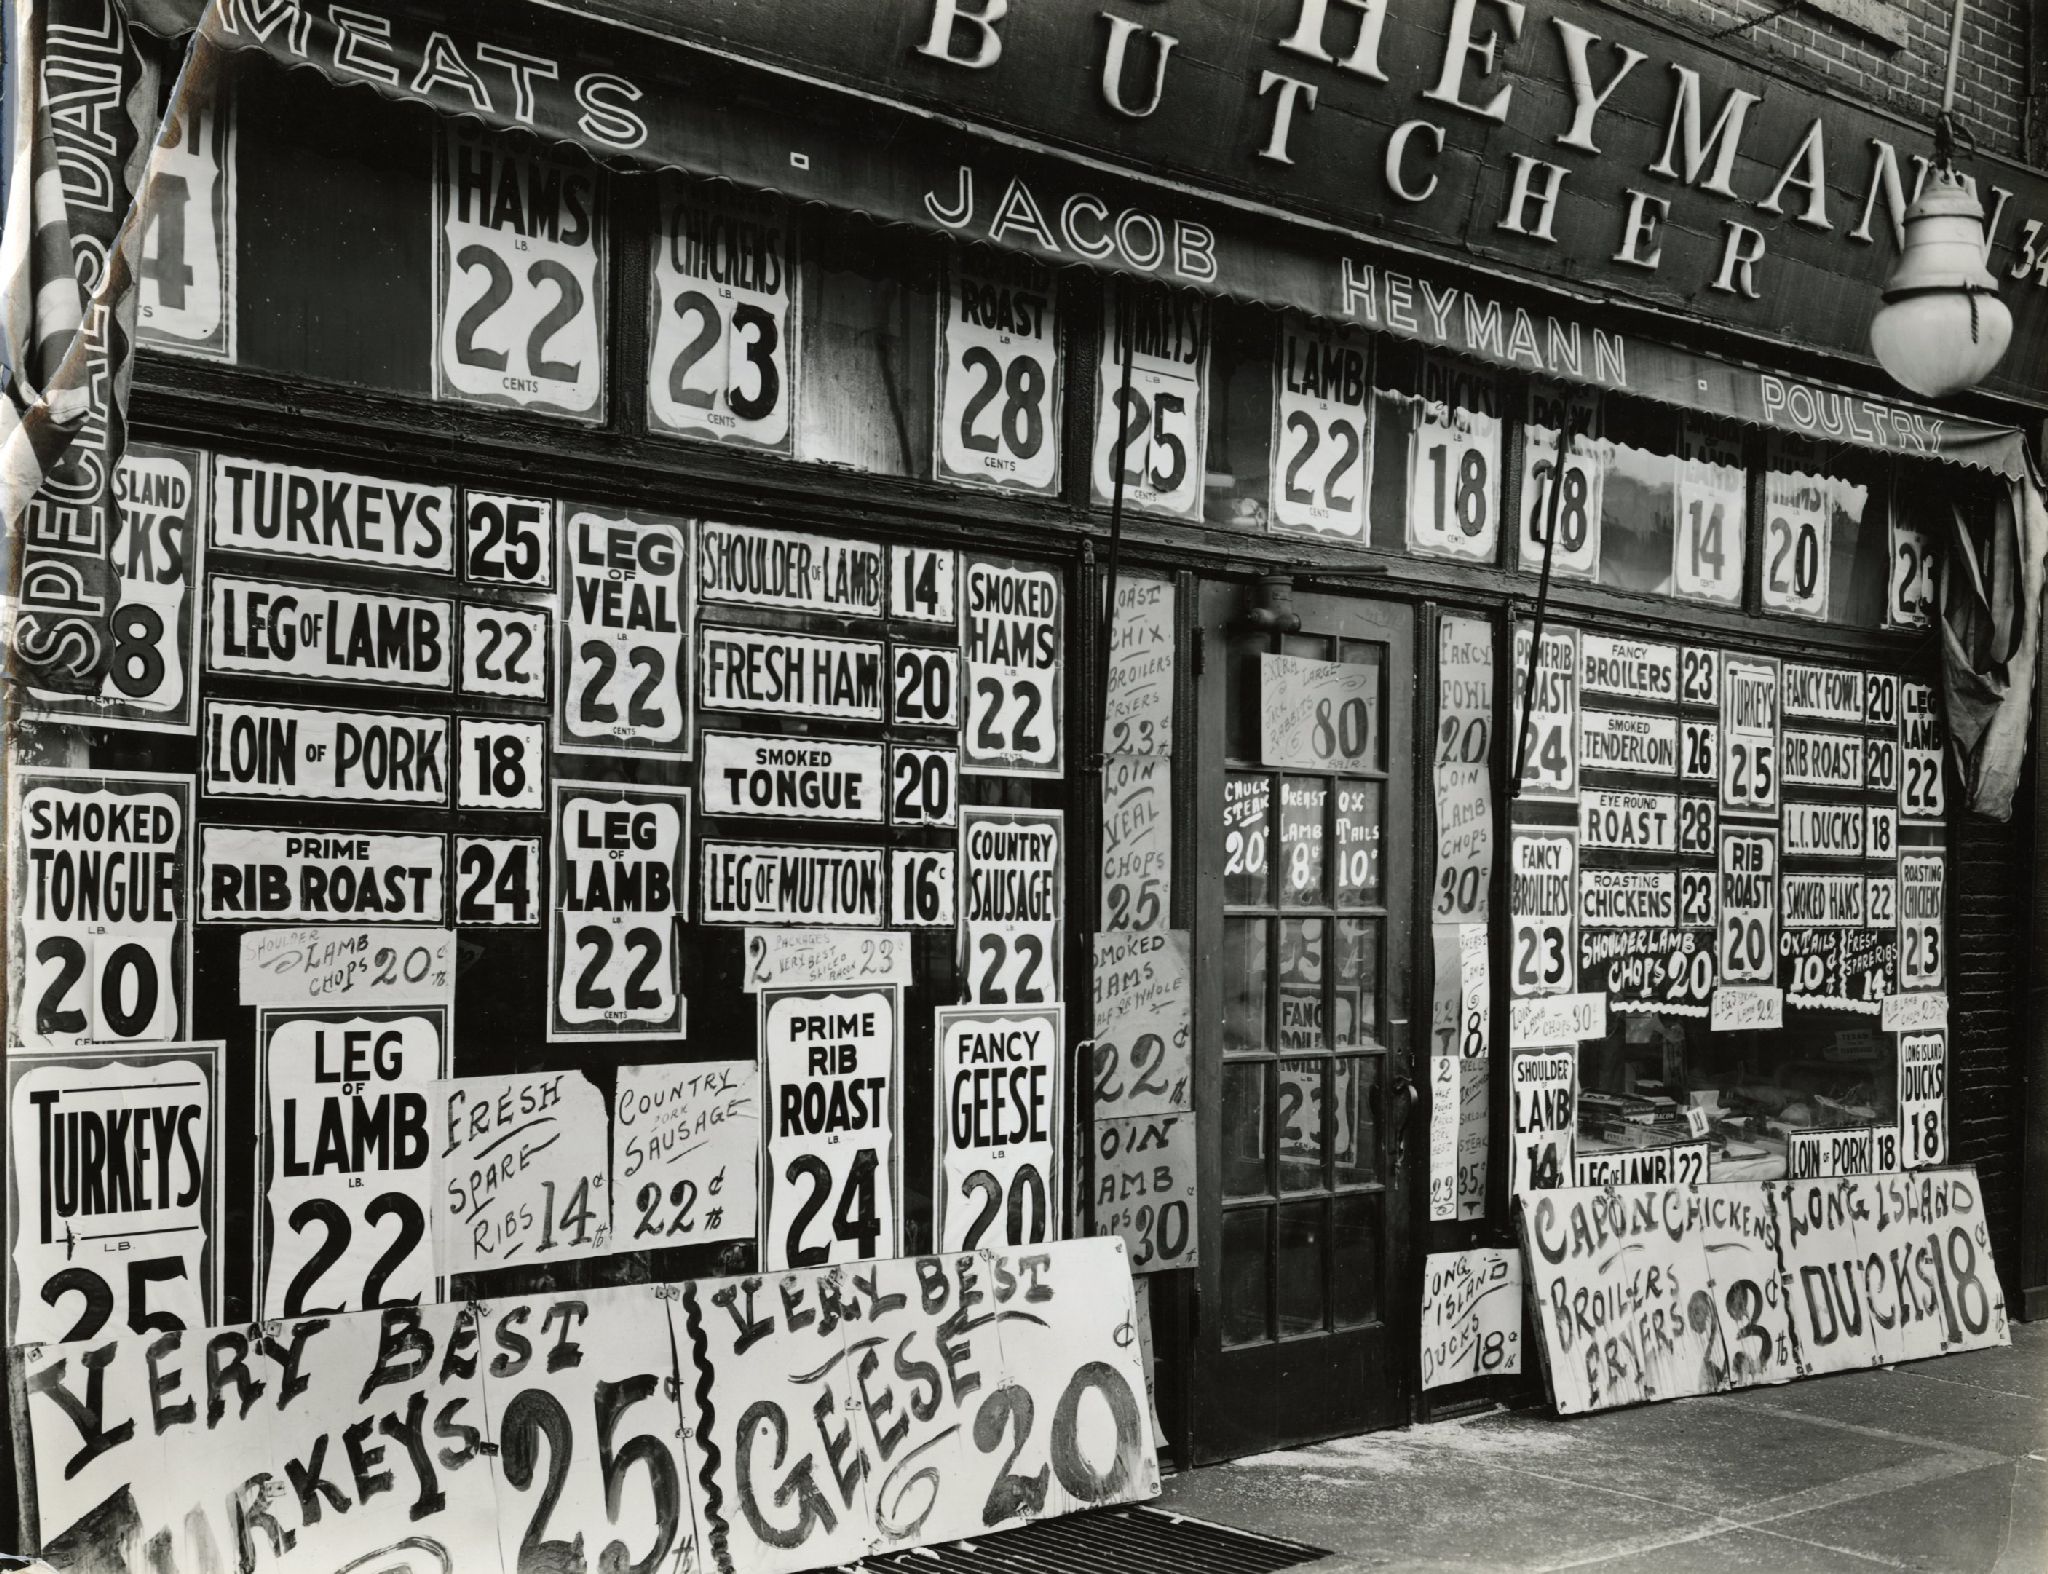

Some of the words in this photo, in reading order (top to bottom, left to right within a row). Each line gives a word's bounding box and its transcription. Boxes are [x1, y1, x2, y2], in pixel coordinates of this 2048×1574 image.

[212, 0, 648, 149] MEATS
[914, 0, 1765, 299] BUTCHER
[923, 166, 1218, 283] JACOB
[1340, 257, 1627, 388] HEYMANN
[502, 377, 540, 394] CENTS
[706, 413, 736, 428] CENTS
[1761, 374, 1944, 453] POULTRY
[984, 456, 1016, 472] CENTS
[225, 466, 442, 559] TURKEYS
[469, 502, 541, 580] 25
[578, 523, 676, 577] LEG
[1690, 500, 1725, 581] 14
[608, 568, 636, 581] OF
[971, 571, 1054, 619] SMOKED
[576, 575, 677, 633] VEAL
[223, 589, 298, 662] LEG
[301, 613, 324, 649] OF
[327, 600, 442, 673] LAMB
[476, 619, 533, 684] 22
[971, 616, 1055, 670] HAMS
[1611, 644, 1648, 660] FANCY
[580, 639, 666, 729] 22
[709, 639, 804, 704] FRESH
[812, 647, 878, 708] HAM
[896, 652, 951, 720] 20
[1108, 655, 1171, 693] BROILERS
[1441, 680, 1491, 710] FOWL
[1586, 655, 1672, 693] BROILERS
[1785, 668, 1823, 709] FANCY
[1824, 673, 1861, 712] FOWL
[977, 677, 1041, 753] 22
[1868, 676, 1894, 721] 20
[612, 726, 636, 736] CENTS
[1112, 720, 1155, 755] 23
[1312, 697, 1369, 760] 80
[1440, 715, 1487, 764] 20
[1584, 730, 1673, 767] TENDERLOIN
[1608, 718, 1651, 735] SMOKED
[212, 713, 297, 786] LOIN
[305, 744, 327, 763] OF
[335, 722, 444, 793] PORK
[474, 735, 526, 798] 18
[755, 748, 832, 767] SMOKED
[1785, 737, 1808, 777] RIB
[1812, 740, 1860, 780] ROAST
[1868, 741, 1894, 787] 20
[724, 768, 863, 810] TONGUE
[895, 752, 949, 820] 20
[1103, 757, 1155, 804] LOIN
[1224, 778, 1270, 801] CHUCK
[1600, 795, 1621, 808] EYE
[1623, 796, 1657, 810] ROUND
[30, 800, 174, 844] SMOKED
[577, 809, 657, 851] LEG
[1223, 795, 1269, 826] STEAK
[1281, 813, 1323, 843] LAMB
[1336, 818, 1379, 844] TAILS
[1439, 798, 1486, 837] LAMB
[1587, 808, 1668, 845] ROAST
[1812, 811, 1860, 850] DUCKS
[286, 838, 371, 861] PRIME
[608, 850, 625, 860] OF
[971, 829, 1053, 862] COUNTRY
[1224, 831, 1265, 876] 20
[1440, 827, 1488, 860] CHOPS
[1871, 815, 1890, 852] 18
[1104, 852, 1165, 880] CHOPS
[1291, 842, 1309, 889] 8
[1338, 849, 1369, 887] 10
[1522, 845, 1562, 869] FANCY
[1732, 842, 1764, 872] RIB
[1904, 864, 1942, 882] ROASTING
[30, 848, 175, 922] TONGUE
[211, 863, 292, 912] RIB
[300, 864, 433, 914] ROAST
[459, 844, 531, 922] 24
[565, 859, 671, 912] LAMB
[710, 853, 752, 912] LEG
[755, 864, 776, 904] OF
[779, 855, 877, 915] MUTTON
[970, 868, 1053, 922] SAUSAGE
[1512, 874, 1569, 916] BROILERS
[1594, 874, 1659, 888] ROASTING
[1723, 874, 1772, 908] ROAST
[1786, 881, 1826, 920] SMOKED
[1830, 881, 1860, 920] HAMS
[1871, 883, 1891, 920] 22
[1904, 885, 1940, 920] CHICKENS
[1106, 879, 1162, 932] 25
[1584, 889, 1672, 918] CHICKENS
[304, 934, 369, 973] LAMB
[749, 935, 772, 984] 2
[860, 939, 894, 976] 23
[1647, 928, 1696, 954] LAMB
[35, 935, 158, 1038] 20
[309, 957, 367, 997] CHOPS
[371, 946, 432, 987] 20
[575, 925, 663, 1010] 22
[979, 933, 1045, 1004] 22
[1666, 950, 1712, 1000] 20
[1790, 955, 1825, 992] 10
[603, 1010, 628, 1020] CENTS
[790, 1012, 875, 1042] PRIME
[315, 1030, 403, 1083] LEG
[808, 1044, 858, 1078] RIB
[958, 1030, 1041, 1064] FANCY
[1921, 1043, 1942, 1062] ISLAND
[342, 1083, 366, 1096] OF
[1517, 1060, 1569, 1082] SHOULDER
[1905, 1063, 1943, 1102] DUCKS
[442, 1075, 564, 1157] FRESH
[618, 1067, 738, 1125] COUNTRY
[780, 1077, 886, 1138] ROAST
[952, 1065, 1047, 1150] GEESE
[1515, 1088, 1571, 1134] LAMB
[283, 1092, 429, 1177] LAMB
[624, 1098, 751, 1178] SAUSAGE
[1877, 1134, 1895, 1171] 18
[30, 1090, 201, 1244] TURKEYS
[1579, 1160, 1609, 1186] LEG
[1621, 1156, 1668, 1185] LAMB
[1678, 1151, 1703, 1184] 22
[1792, 1139, 1820, 1178] LOIN
[1832, 1137, 1868, 1176] PORK
[633, 1180, 699, 1240] 22
[786, 1147, 881, 1268] 24
[1534, 1189, 1660, 1264] CAPON
[1783, 1182, 1870, 1248] LONG
[1876, 1176, 1974, 1232] ISLAND
[473, 1203, 533, 1259] RIBS
[1133, 1200, 1190, 1266] 30
[284, 1192, 425, 1319] 22
[915, 1253, 1054, 1317] BEST
[1801, 1240, 1938, 1347] DUCKS
[1551, 1264, 1680, 1354] BROILERS
[1472, 1330, 1505, 1373] 18
[29, 1318, 330, 1480] VERY
[359, 1300, 589, 1404] BEST
[972, 1360, 1142, 1527] 20
